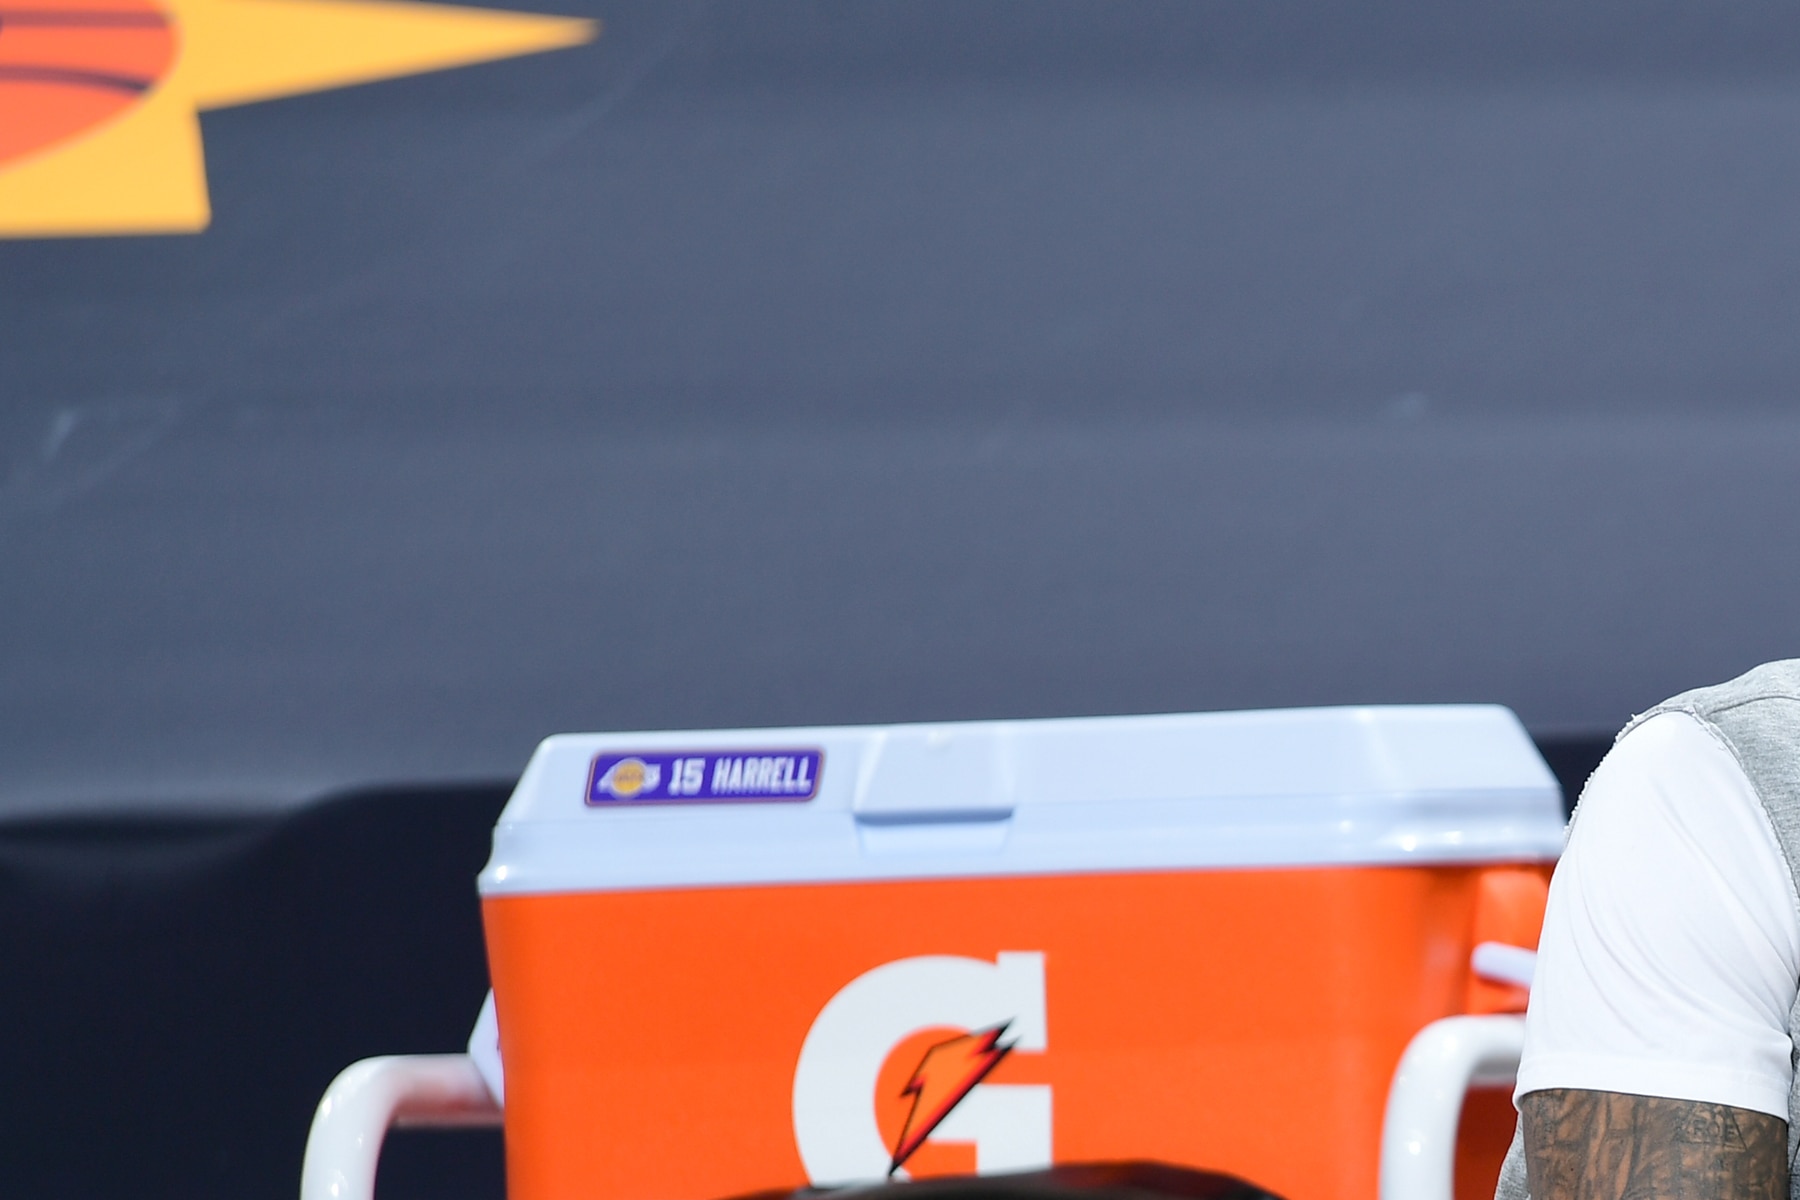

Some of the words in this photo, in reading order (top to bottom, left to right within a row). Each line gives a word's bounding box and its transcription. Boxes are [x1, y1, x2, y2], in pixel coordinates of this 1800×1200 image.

[668, 758, 706, 796] 15
[711, 756, 812, 795] HARRELL
[792, 950, 1054, 1184] G
